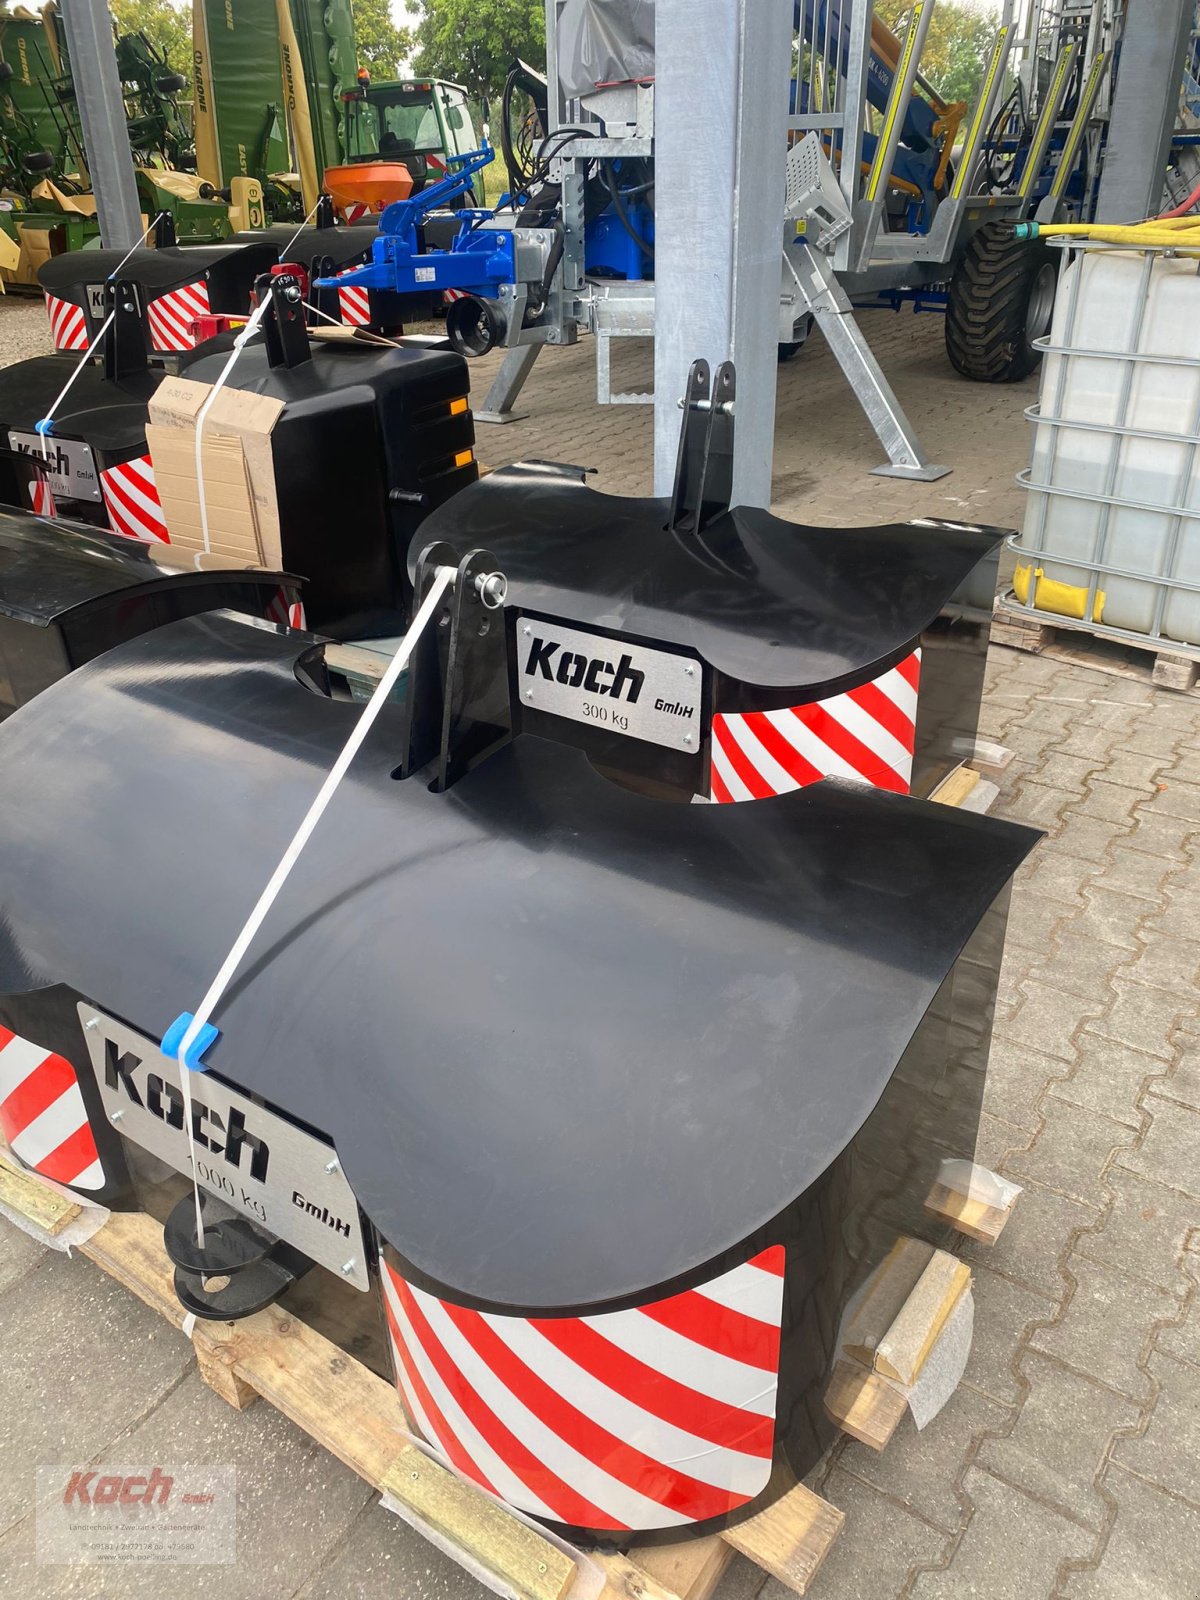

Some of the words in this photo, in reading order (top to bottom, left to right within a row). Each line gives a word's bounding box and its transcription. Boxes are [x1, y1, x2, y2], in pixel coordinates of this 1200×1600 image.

[225, 0, 234, 31] ONE
[195, 65, 208, 114] KRONE
[283, 43, 295, 93] KRONE
[525, 637, 646, 704] Koch
[582, 702, 608, 721] 300
[611, 710, 629, 731] kg
[654, 698, 694, 719] GmbH
[104, 1037, 270, 1186] Koch
[240, 1188, 267, 1222] kg
[291, 1190, 351, 1239] GmbH
